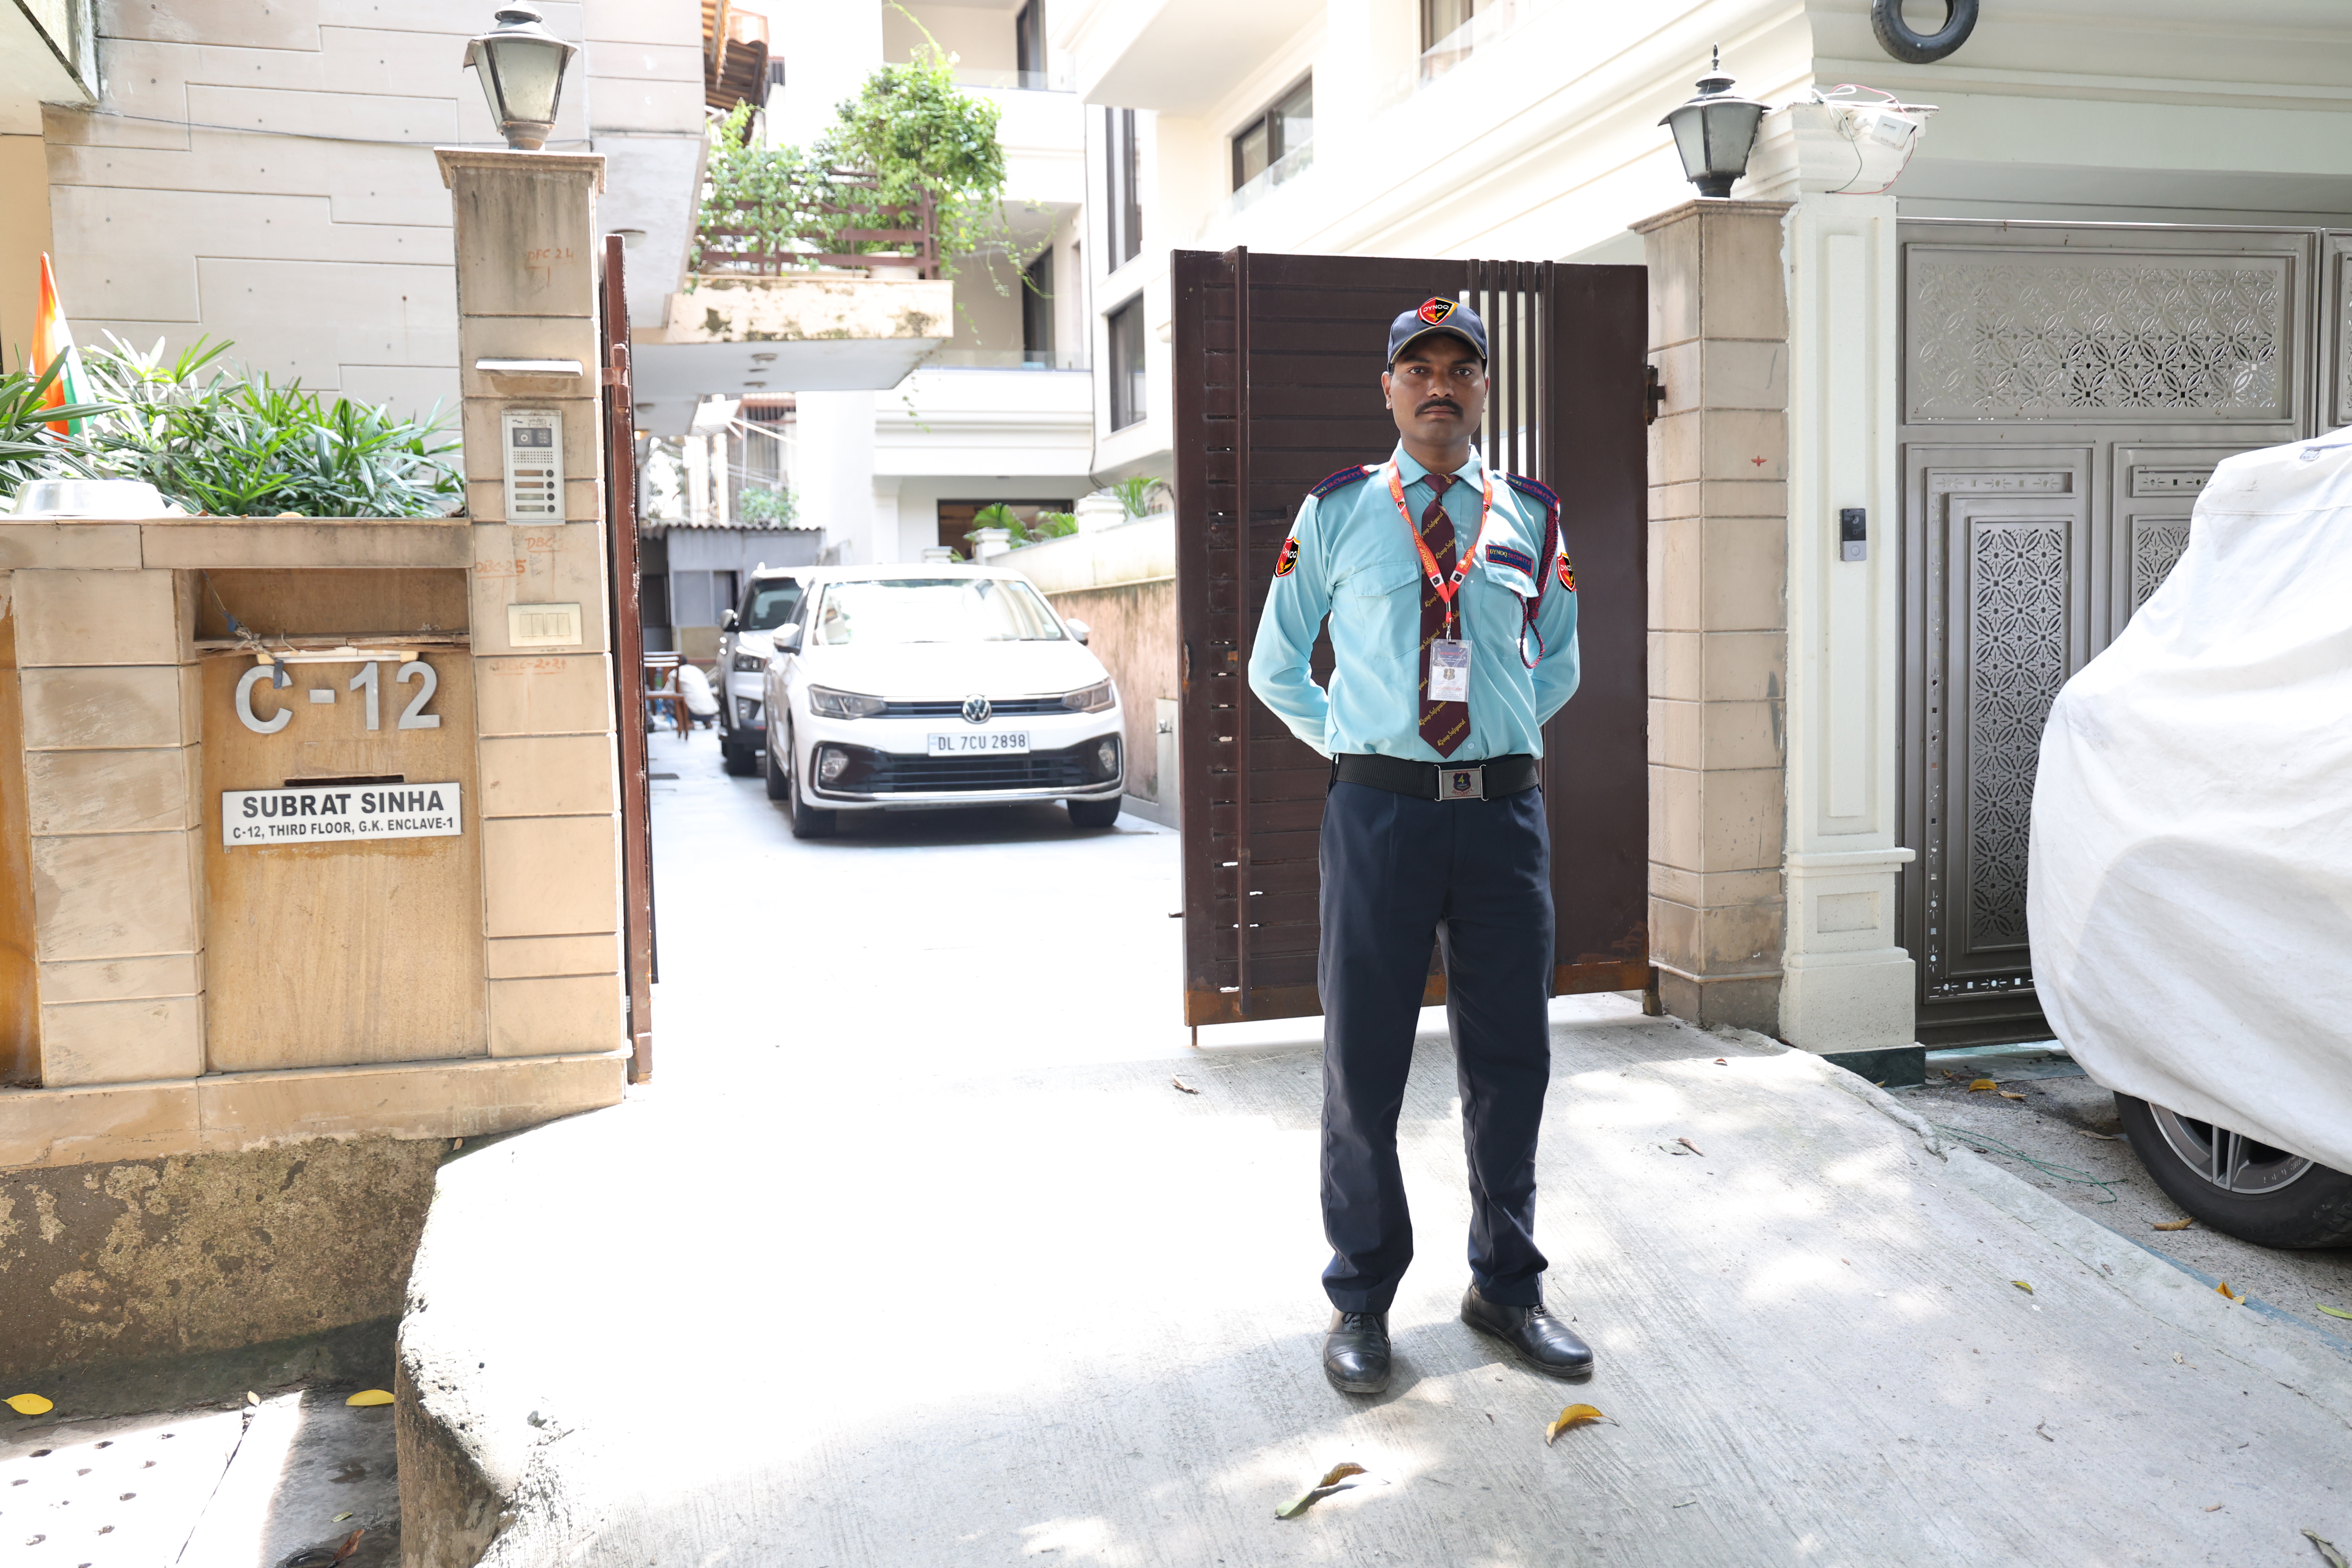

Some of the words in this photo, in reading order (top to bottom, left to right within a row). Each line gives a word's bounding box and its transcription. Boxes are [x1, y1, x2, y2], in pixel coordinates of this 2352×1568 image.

[1423, 304, 1449, 313] DYNOQ
[1326, 470, 1360, 488] SECURITY
[1522, 483, 1555, 503] SECURITY
[1427, 511, 1444, 530] Safeguard
[1283, 547, 1297, 559] DYNOQ
[1419, 548, 1434, 573] 4GROUP
[1490, 549, 1507, 557] DYNOQ
[1508, 553, 1531, 565] SECURITY
[1437, 734, 1450, 746] 4Group
[1448, 718, 1466, 736] Safeguard
[938, 737, 955, 750] DL
[960, 735, 986, 750] 7CU
[992, 734, 1025, 748] 2898
[1457, 774, 1465, 784] 4
[1452, 788, 1473, 796] SECURITY
[243, 793, 351, 818] SUBRAT
[361, 790, 444, 814] SINHA
[233, 826, 265, 840] C-12,
[269, 824, 307, 837] THIRD
[310, 822, 355, 835] FLOOR,
[359, 820, 383, 832] G.K.
[388, 817, 453, 831] ENCLAVE-1
